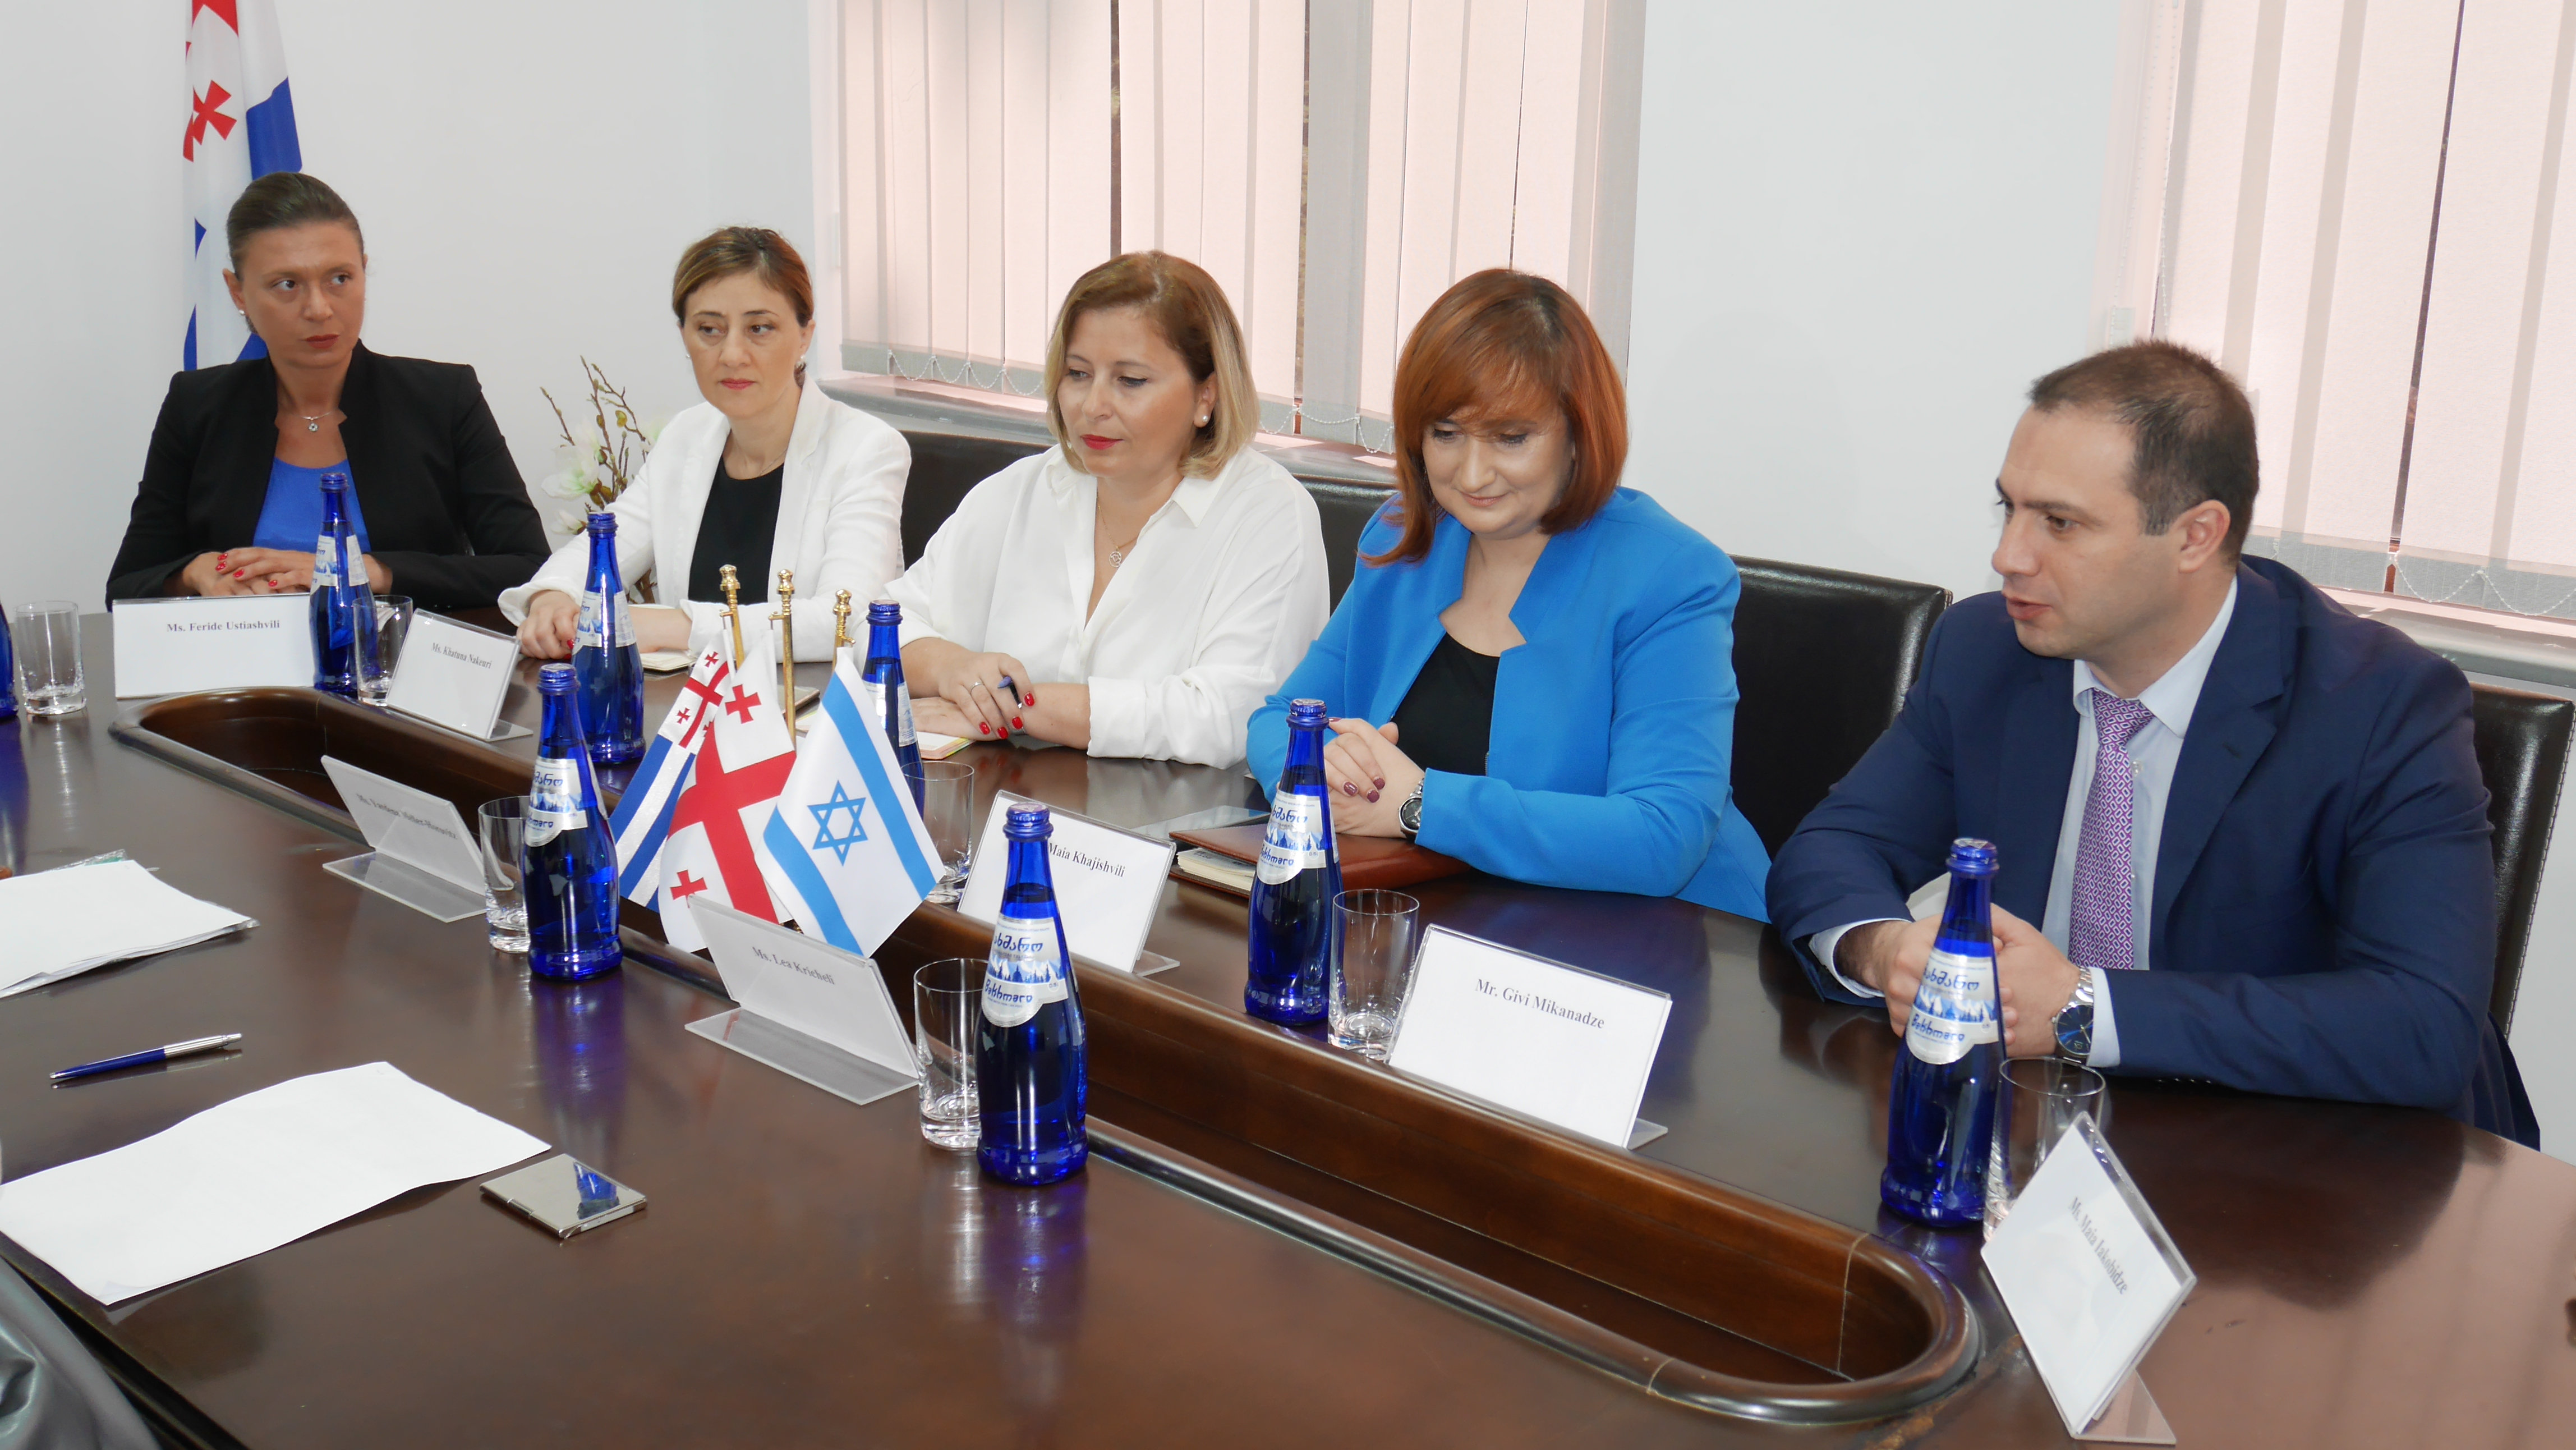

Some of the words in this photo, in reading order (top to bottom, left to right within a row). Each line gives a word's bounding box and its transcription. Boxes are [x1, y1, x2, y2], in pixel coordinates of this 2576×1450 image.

[167, 623, 186, 632] Ms.
[190, 622, 223, 631] Feride
[226, 620, 280, 630] Ustiashvili
[431, 643, 441, 653] Ms.
[443, 646, 467, 661] Khatuna
[468, 654, 493, 669] Nakeuri
[1048, 842, 1070, 860] Maia
[1072, 851, 1126, 878] Khajishvili
[752, 947, 772, 962] Ms.
[772, 954, 792, 969] Lea
[793, 961, 835, 985] Kricheli
[985, 979, 1033, 1003] Bakhmaro
[1474, 979, 1498, 997] Mr.
[1502, 987, 1530, 1006] Givi
[1531, 995, 1605, 1029] Mikanadze
[2078, 1214, 2097, 1247] Maia
[2094, 1239, 2128, 1295] Iakobidze
